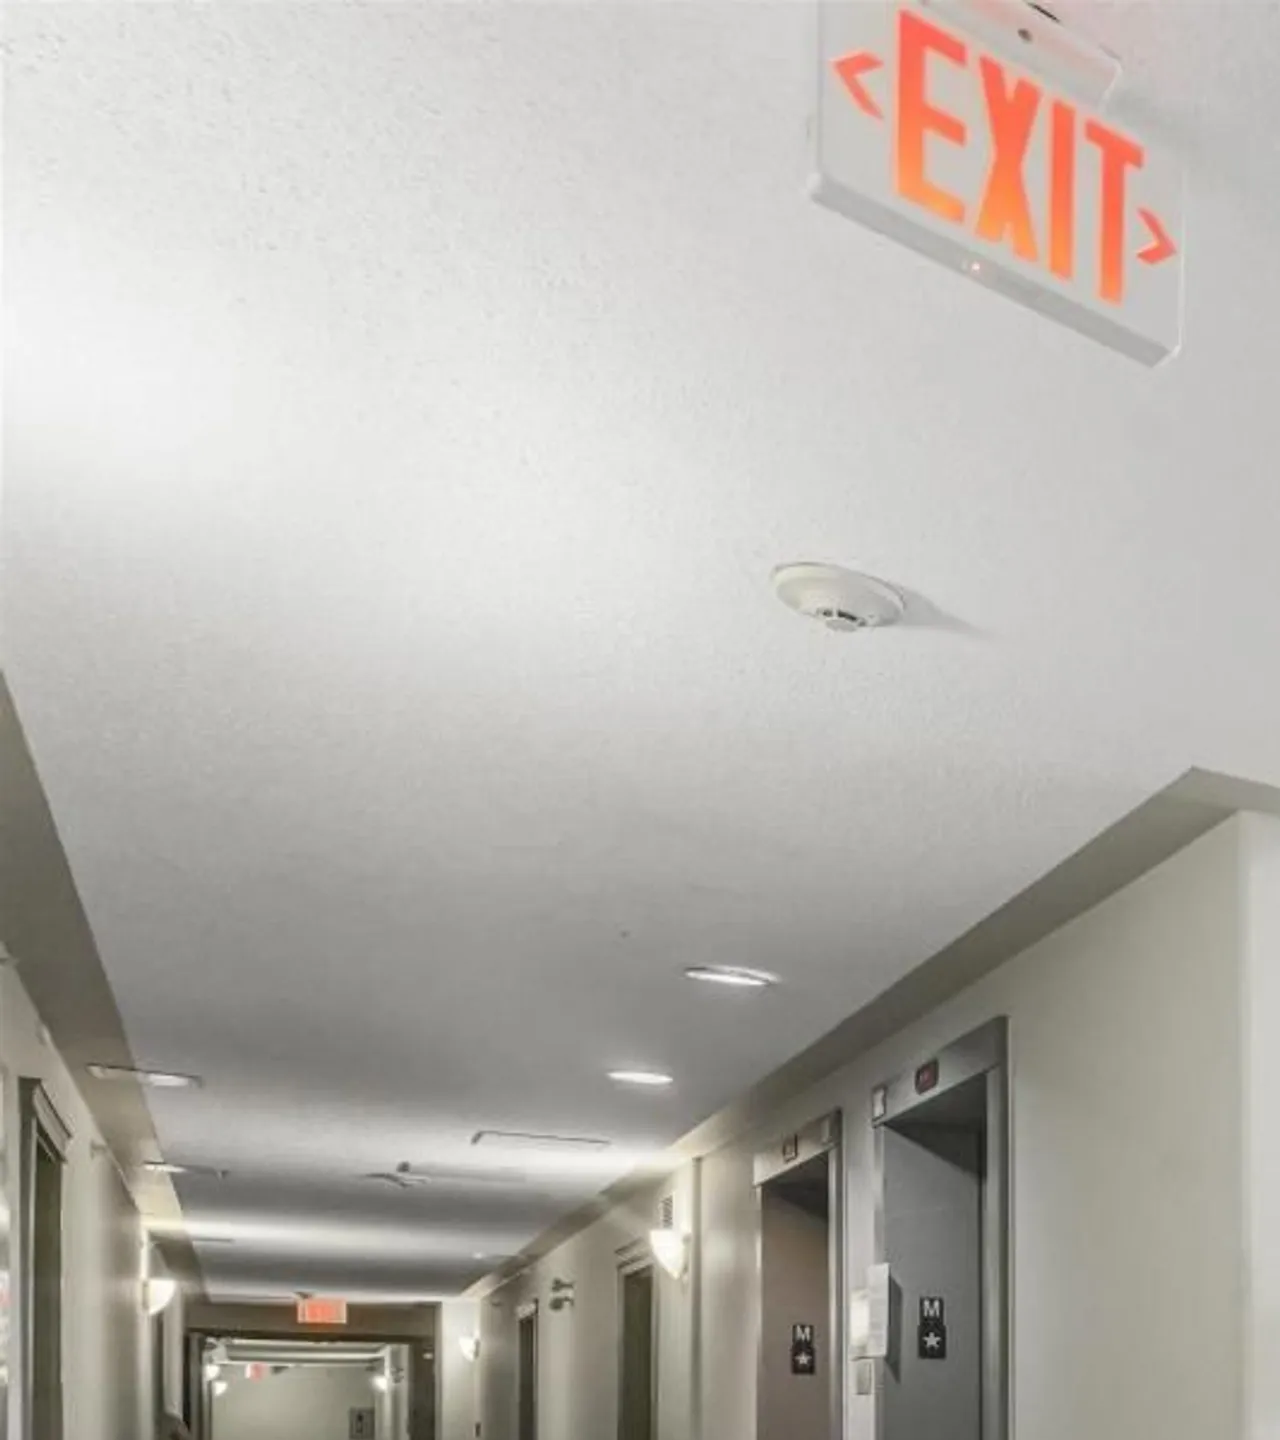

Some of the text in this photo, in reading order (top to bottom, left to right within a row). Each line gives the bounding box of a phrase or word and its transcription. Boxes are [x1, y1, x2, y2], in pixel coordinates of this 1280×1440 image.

[896, 8, 1145, 306] EXIT
[923, 1299, 941, 1318] M
[796, 1325, 811, 1342] M
